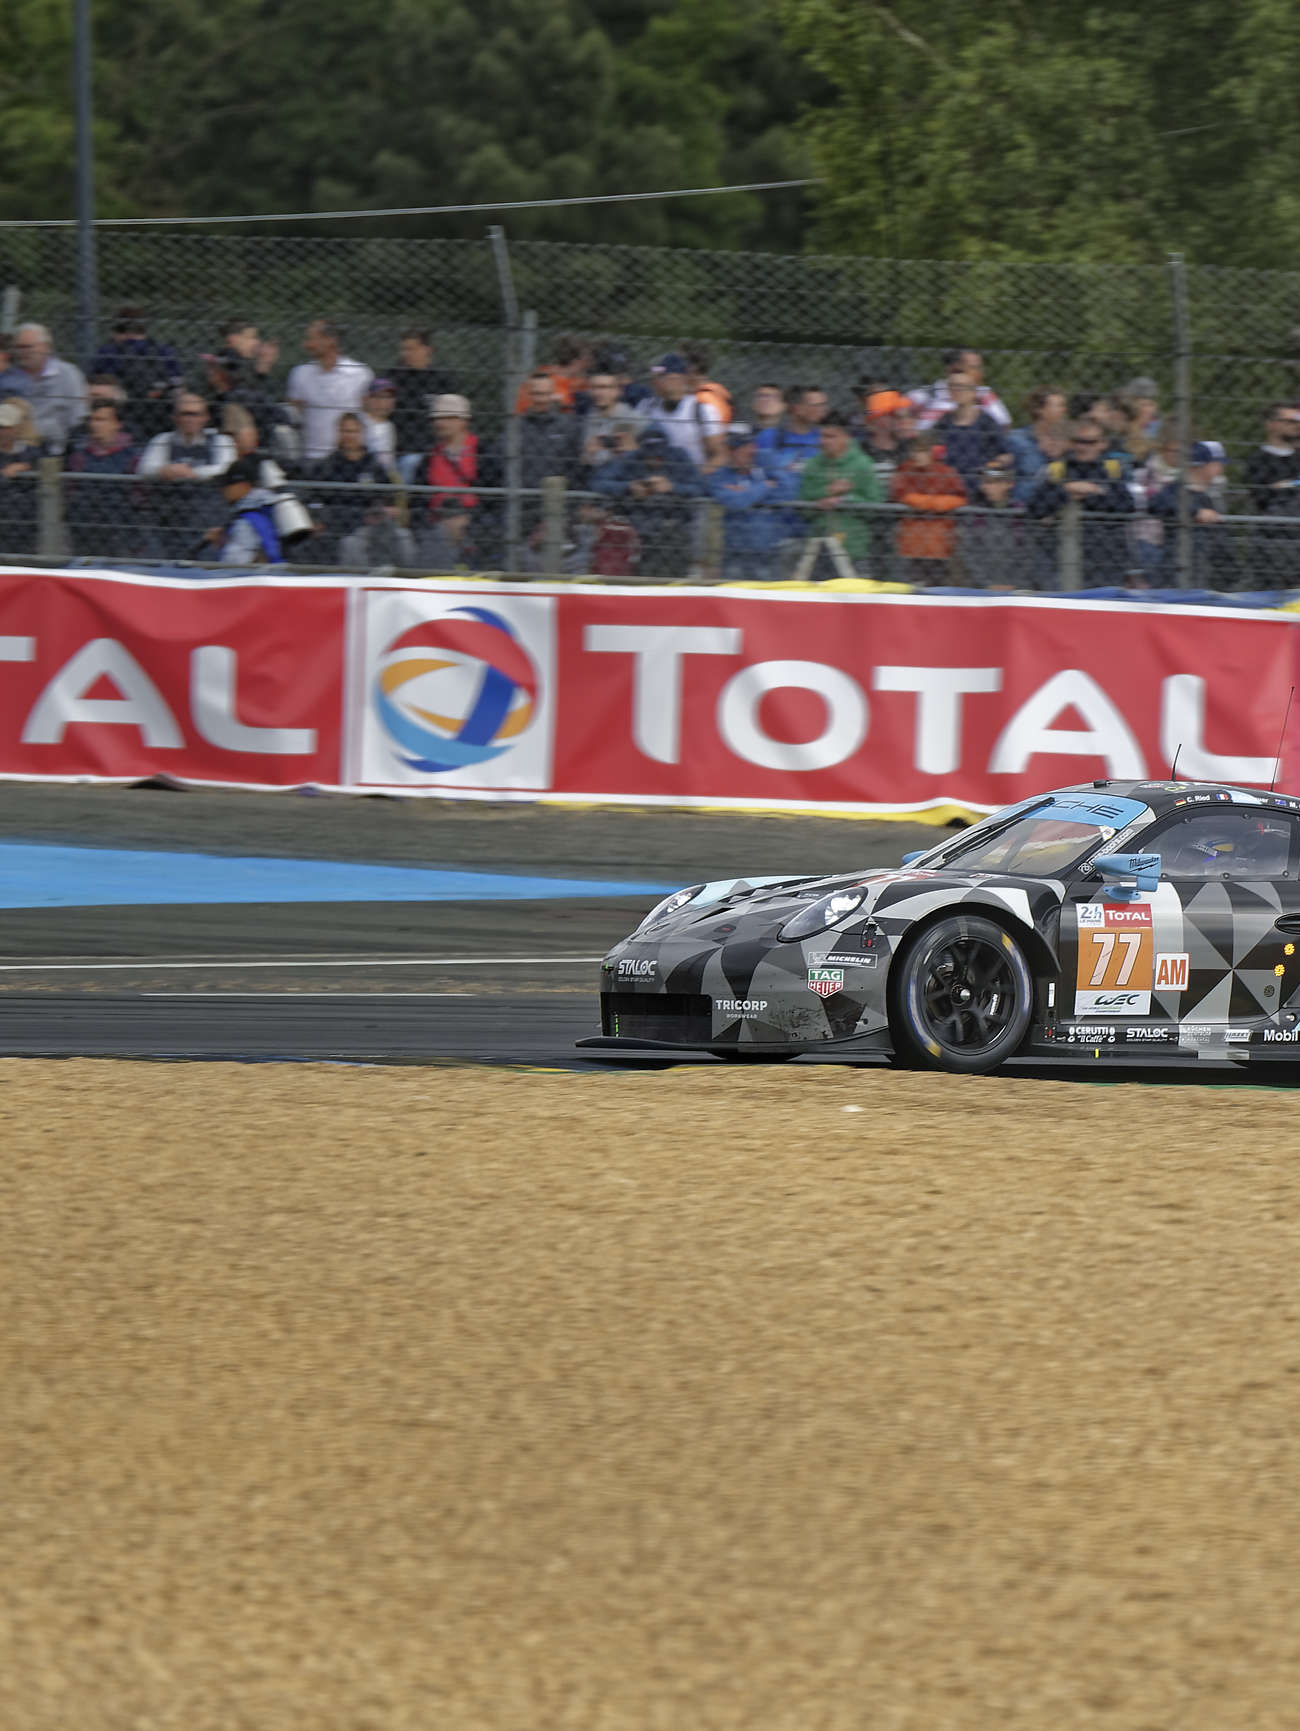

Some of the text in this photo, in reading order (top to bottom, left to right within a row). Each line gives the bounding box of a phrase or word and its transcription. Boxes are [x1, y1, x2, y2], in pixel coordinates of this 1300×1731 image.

[584, 624, 1282, 783] TOTAL
[1106, 910, 1151, 921] TOTAL
[826, 955, 872, 964] MICHELIN
[1089, 933, 1142, 986] 77
[618, 959, 657, 976] STALOC
[1156, 959, 1187, 985] AM
[810, 970, 841, 981] TAG
[809, 981, 842, 996] HEUER
[715, 999, 768, 1011] TRICORP
[1094, 994, 1140, 1006] WEC
[1075, 1026, 1109, 1035] CERUTTI
[1126, 1028, 1168, 1038] STALOC
[1263, 1029, 1298, 1042] Mobil
